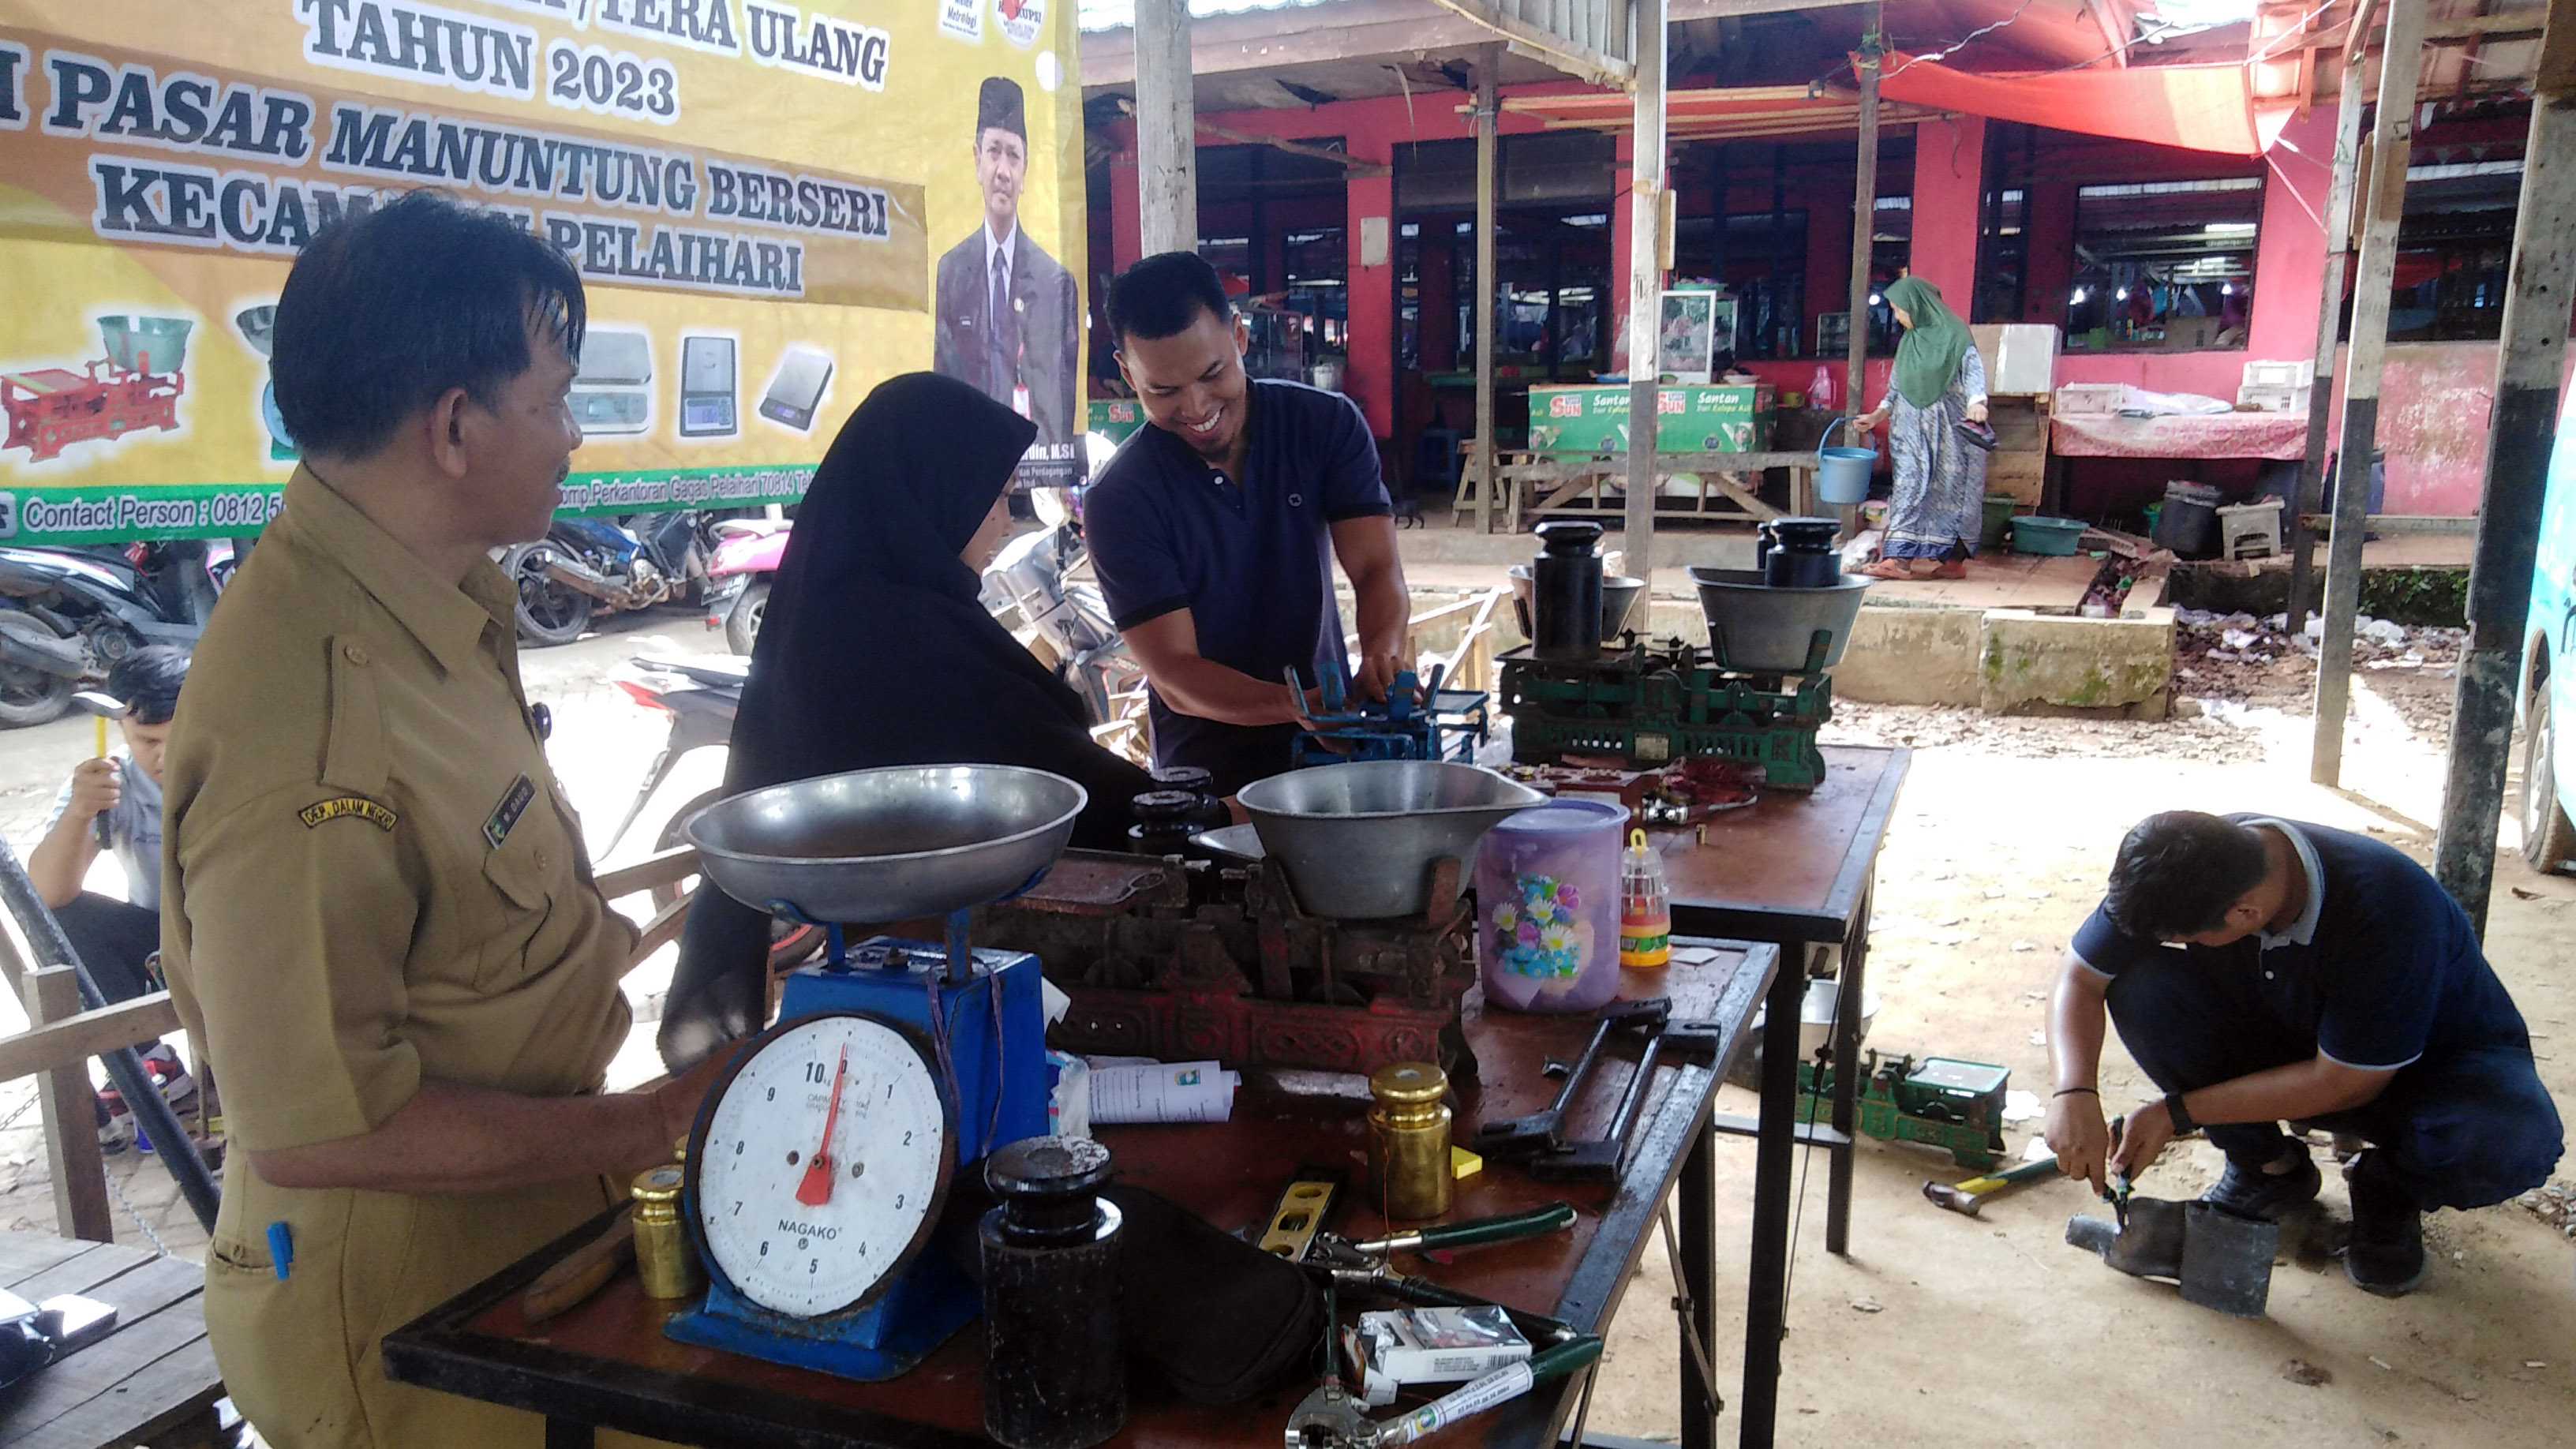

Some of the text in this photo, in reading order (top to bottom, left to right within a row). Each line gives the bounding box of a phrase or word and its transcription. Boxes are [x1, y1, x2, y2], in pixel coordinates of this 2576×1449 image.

[998, 1, 1042, 24] KRUPSI
[746, 5, 886, 84] ULANG
[301, 0, 675, 116] TAHUN 2023
[49, 59, 310, 159] PASAR
[327, 108, 695, 211] MANUNTUNG
[709, 166, 888, 236] BERSERI
[546, 218, 801, 291] PELAIHARI
[1697, 391, 1739, 403] Santan
[671, 478, 708, 504] Gagas
[761, 473, 793, 495] 70814
[25, 499, 114, 529] Contact
[120, 499, 194, 523] Person
[214, 496, 263, 521] 0812
[331, 799, 364, 814] DALAM
[806, 1061, 825, 1084] 10
[767, 1087, 775, 1102] 9
[887, 1084, 893, 1099] 1
[903, 1131, 912, 1146] 2
[736, 1140, 743, 1155] 8
[733, 1201, 743, 1216] 7
[895, 1194, 904, 1210] 3
[777, 1219, 837, 1241] NAGAKO
[760, 1241, 769, 1256] 6
[858, 1241, 867, 1257] 4
[809, 1258, 818, 1275] 5
